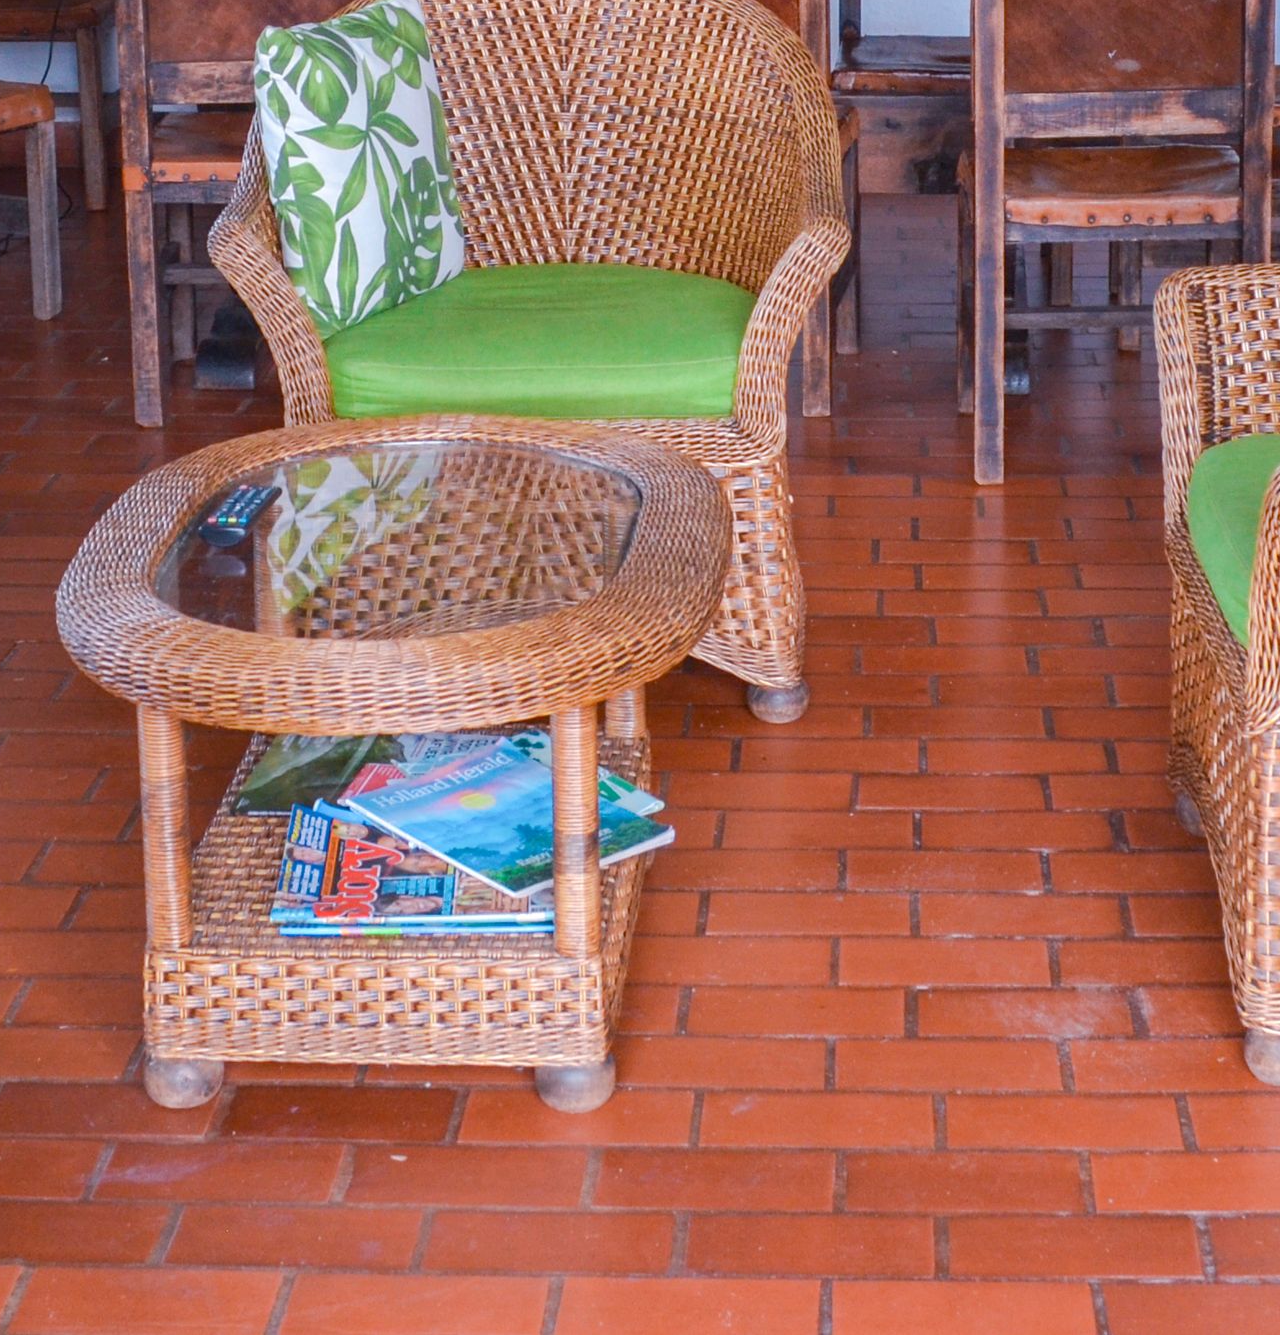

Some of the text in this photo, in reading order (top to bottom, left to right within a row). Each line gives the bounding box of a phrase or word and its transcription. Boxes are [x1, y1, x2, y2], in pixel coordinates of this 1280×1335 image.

[371, 751, 515, 808] Holland Herald
[313, 838, 405, 918] Story
